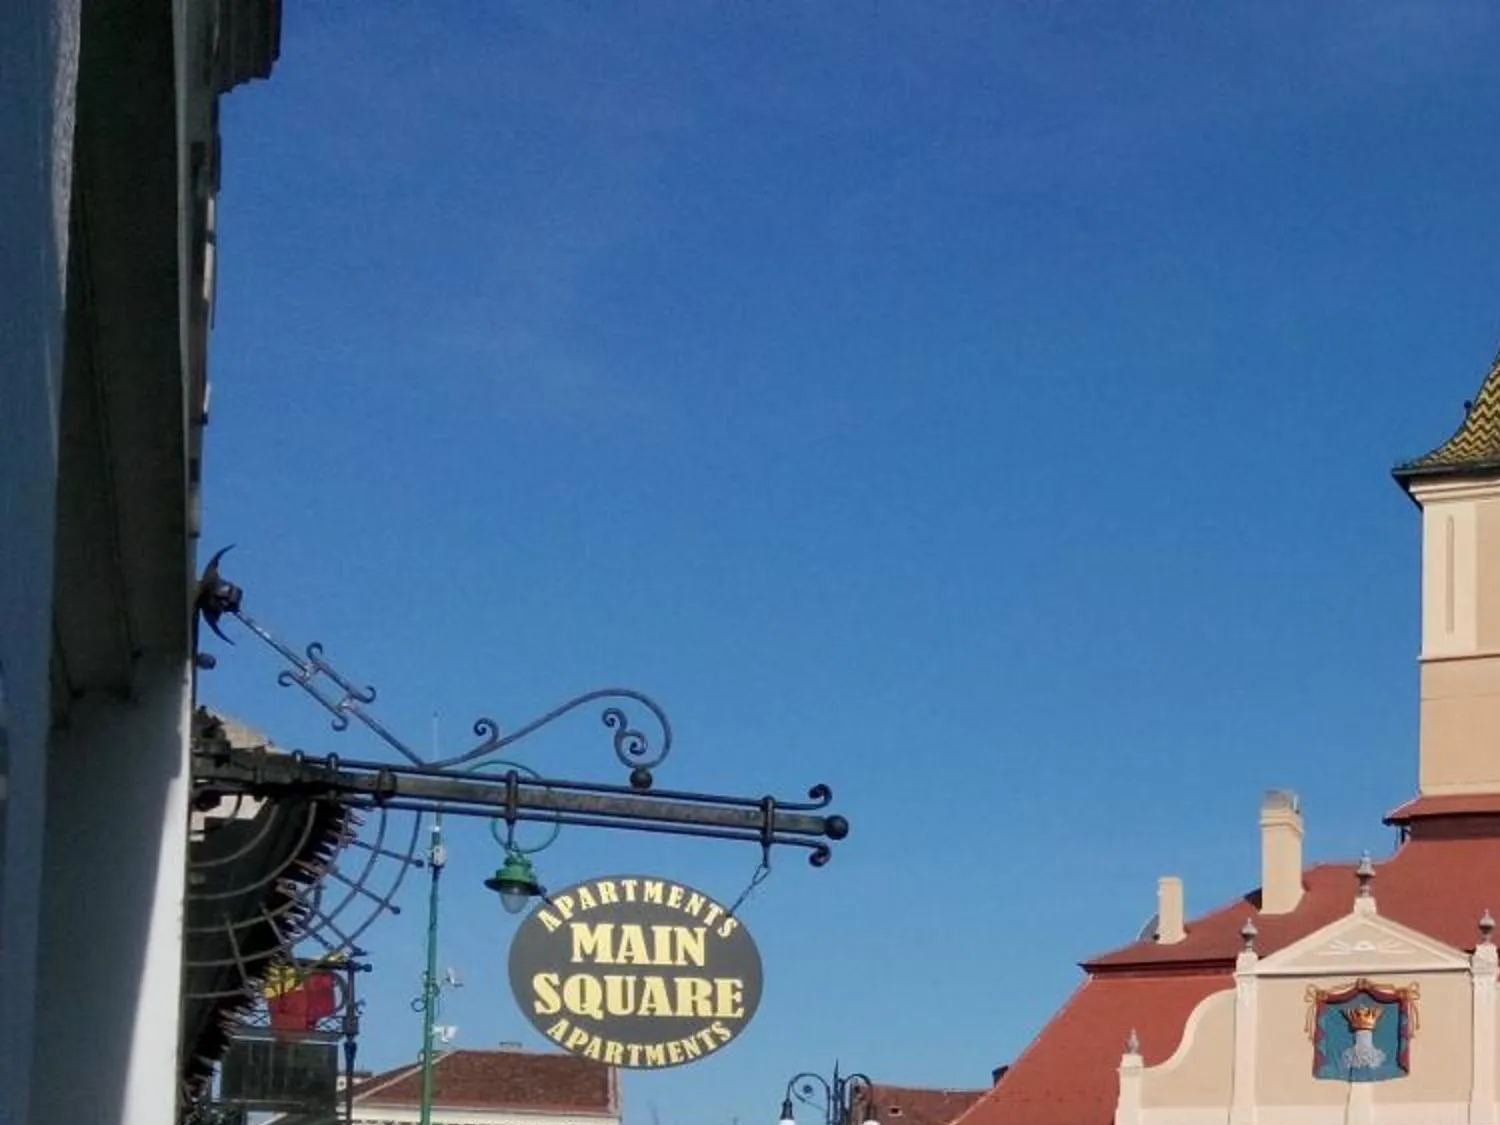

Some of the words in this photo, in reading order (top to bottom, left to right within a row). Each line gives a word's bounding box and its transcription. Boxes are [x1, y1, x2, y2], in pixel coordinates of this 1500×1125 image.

[537, 879, 738, 938] APARTMENTS
[570, 923, 707, 966] MAIN
[532, 973, 745, 1020] SQUARE
[547, 1018, 732, 1067] APARTMENTS
